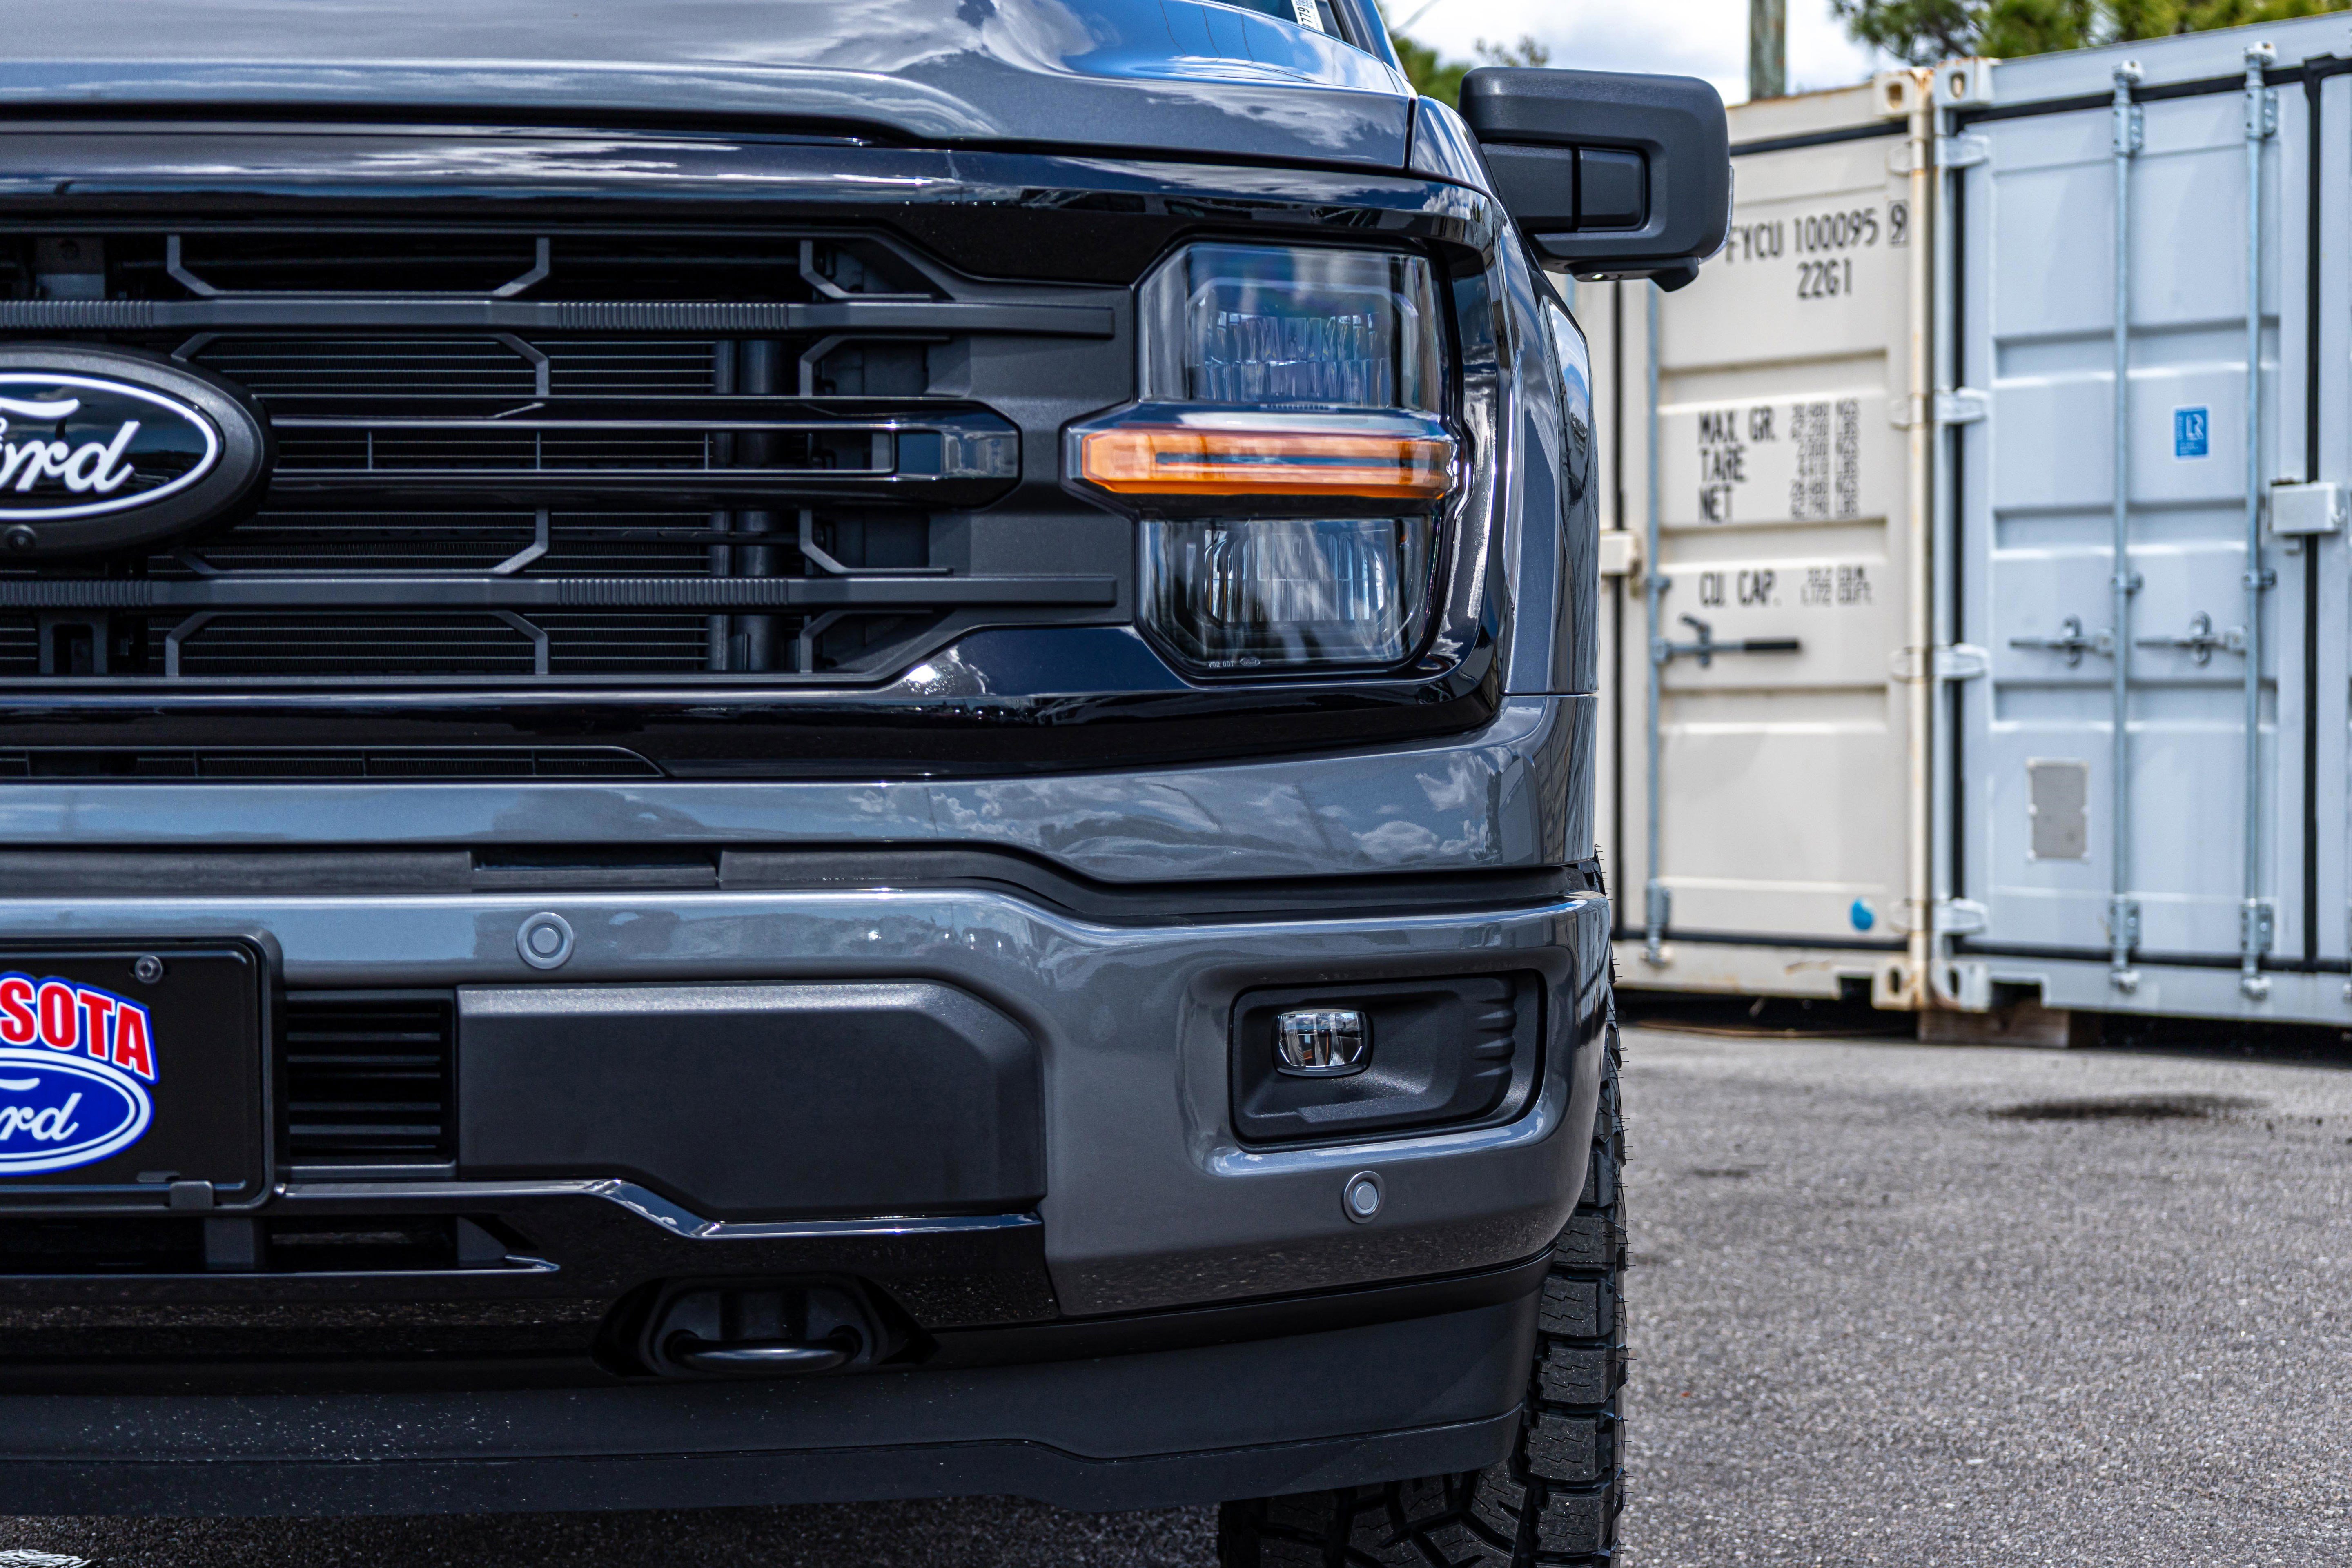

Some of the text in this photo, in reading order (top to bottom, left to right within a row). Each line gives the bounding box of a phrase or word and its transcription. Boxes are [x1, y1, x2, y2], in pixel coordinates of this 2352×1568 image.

[1795, 208, 1878, 252] 100095
[1891, 204, 1907, 239] 9
[1700, 446, 1747, 483] TARE
[1699, 485, 1733, 522] NET
